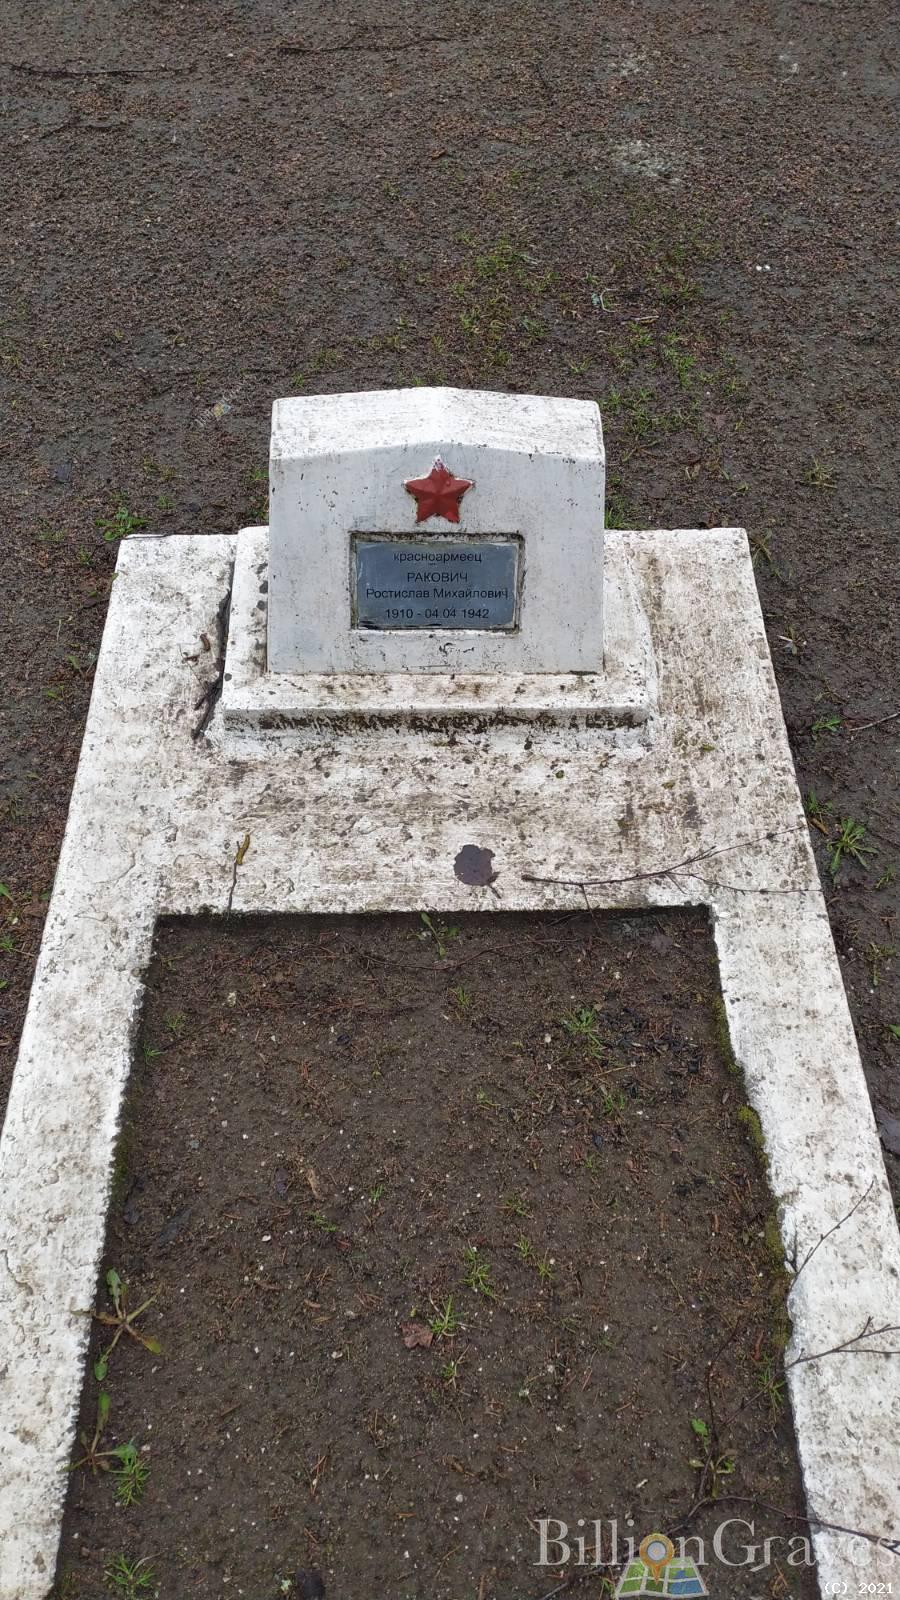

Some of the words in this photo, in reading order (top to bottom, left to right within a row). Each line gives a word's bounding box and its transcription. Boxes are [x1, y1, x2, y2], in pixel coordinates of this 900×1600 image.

[393, 552, 482, 563] красноармеец
[407, 572, 468, 583] РАКОВИЧ
[366, 588, 430, 599] Ростислав
[433, 588, 509, 599] Михайлович
[385, 609, 414, 619] 1910
